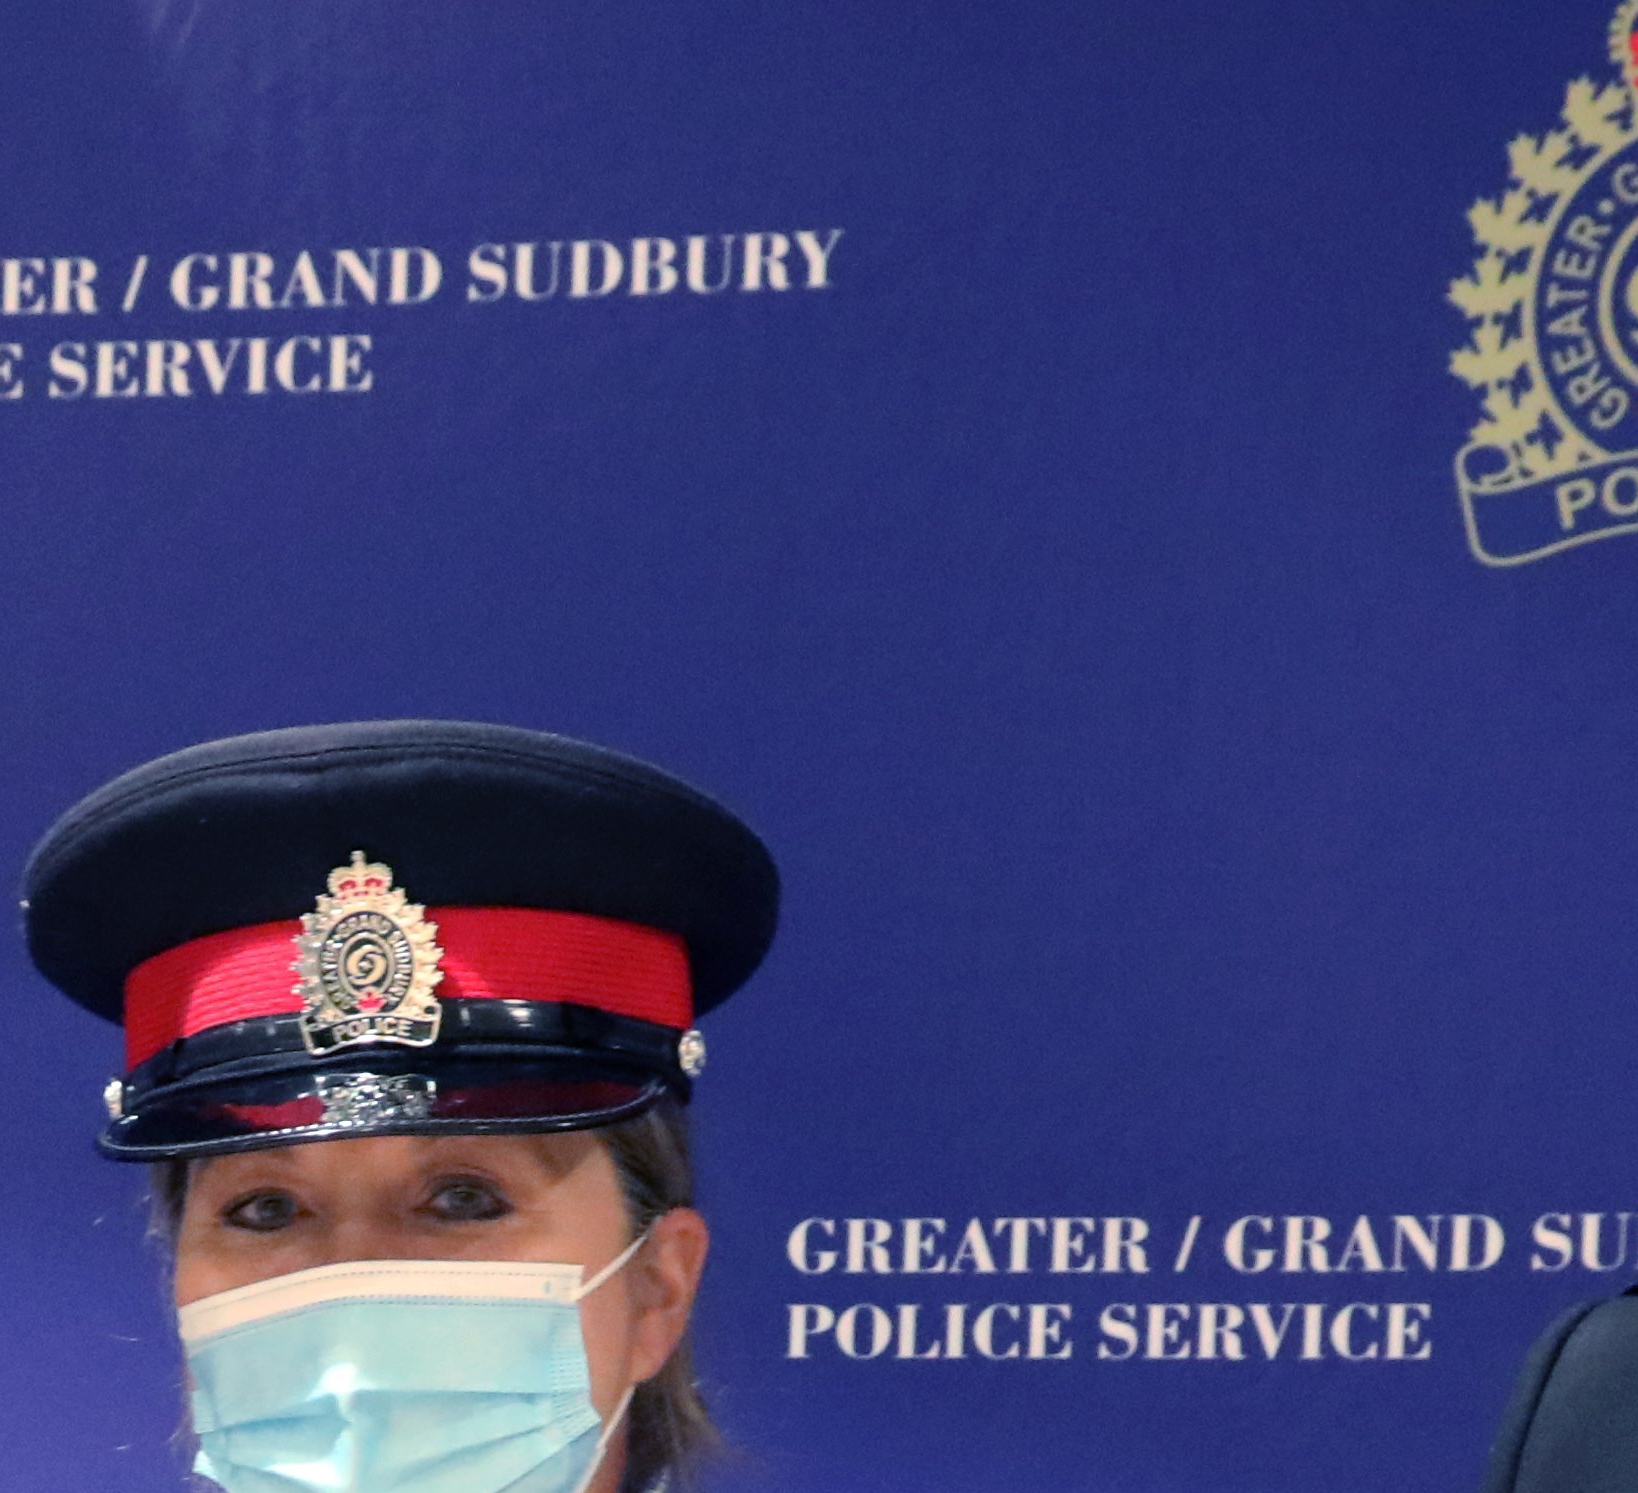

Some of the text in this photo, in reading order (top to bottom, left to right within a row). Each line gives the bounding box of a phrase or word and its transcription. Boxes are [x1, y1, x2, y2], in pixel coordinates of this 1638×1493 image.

[168, 245, 445, 313] GRAND
[465, 227, 843, 304] SUDBURY
[46, 332, 375, 400] SERVICE
[784, 1215, 1152, 1277] GREATER
[1221, 1212, 1507, 1275] GRAND
[785, 1300, 1433, 1363] POLICE SERVICE
